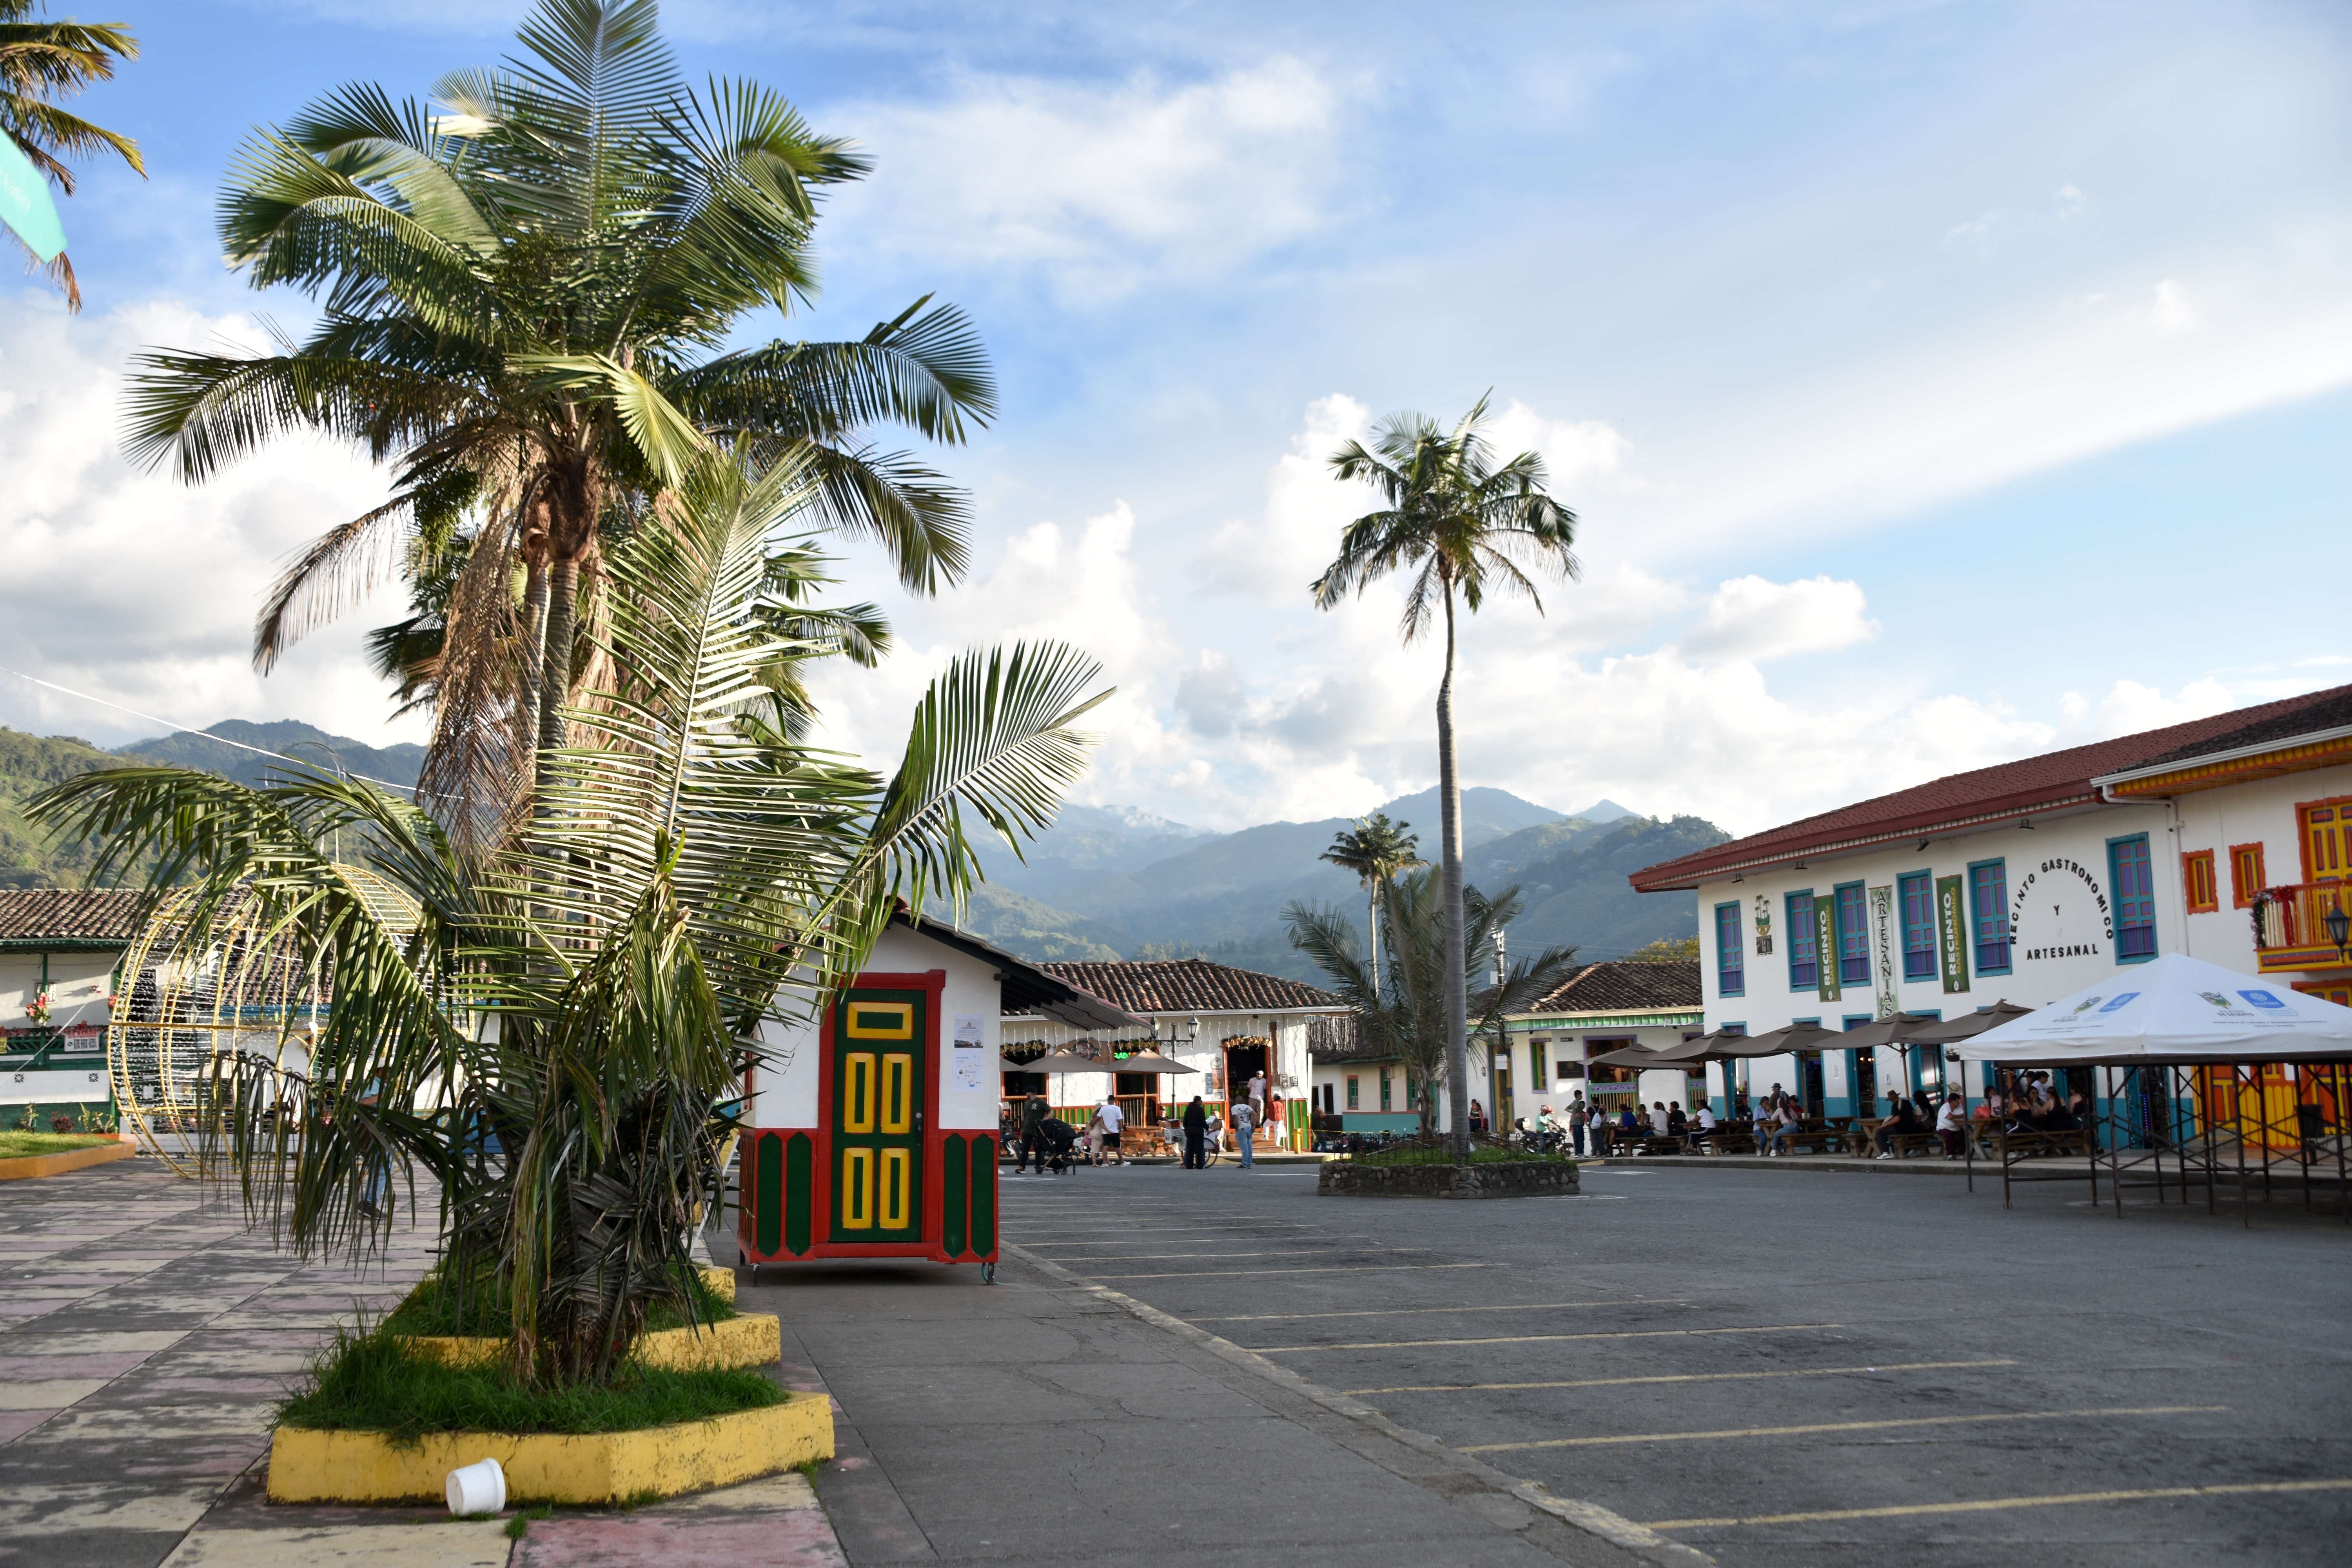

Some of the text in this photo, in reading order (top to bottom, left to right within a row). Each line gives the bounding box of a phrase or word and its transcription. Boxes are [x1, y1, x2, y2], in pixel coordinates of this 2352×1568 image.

[1944, 893, 1956, 975] RECINTO
[1951, 887, 1961, 974] GASTRONOMICO
[2010, 858, 2113, 945] RECINTO GASTRONOMICO
[2053, 905, 2060, 916] Y
[1820, 910, 1831, 985] RECINTO
[1877, 891, 1893, 1017] ARTESANIAS
[2027, 943, 2098, 960] ARTESANAL
